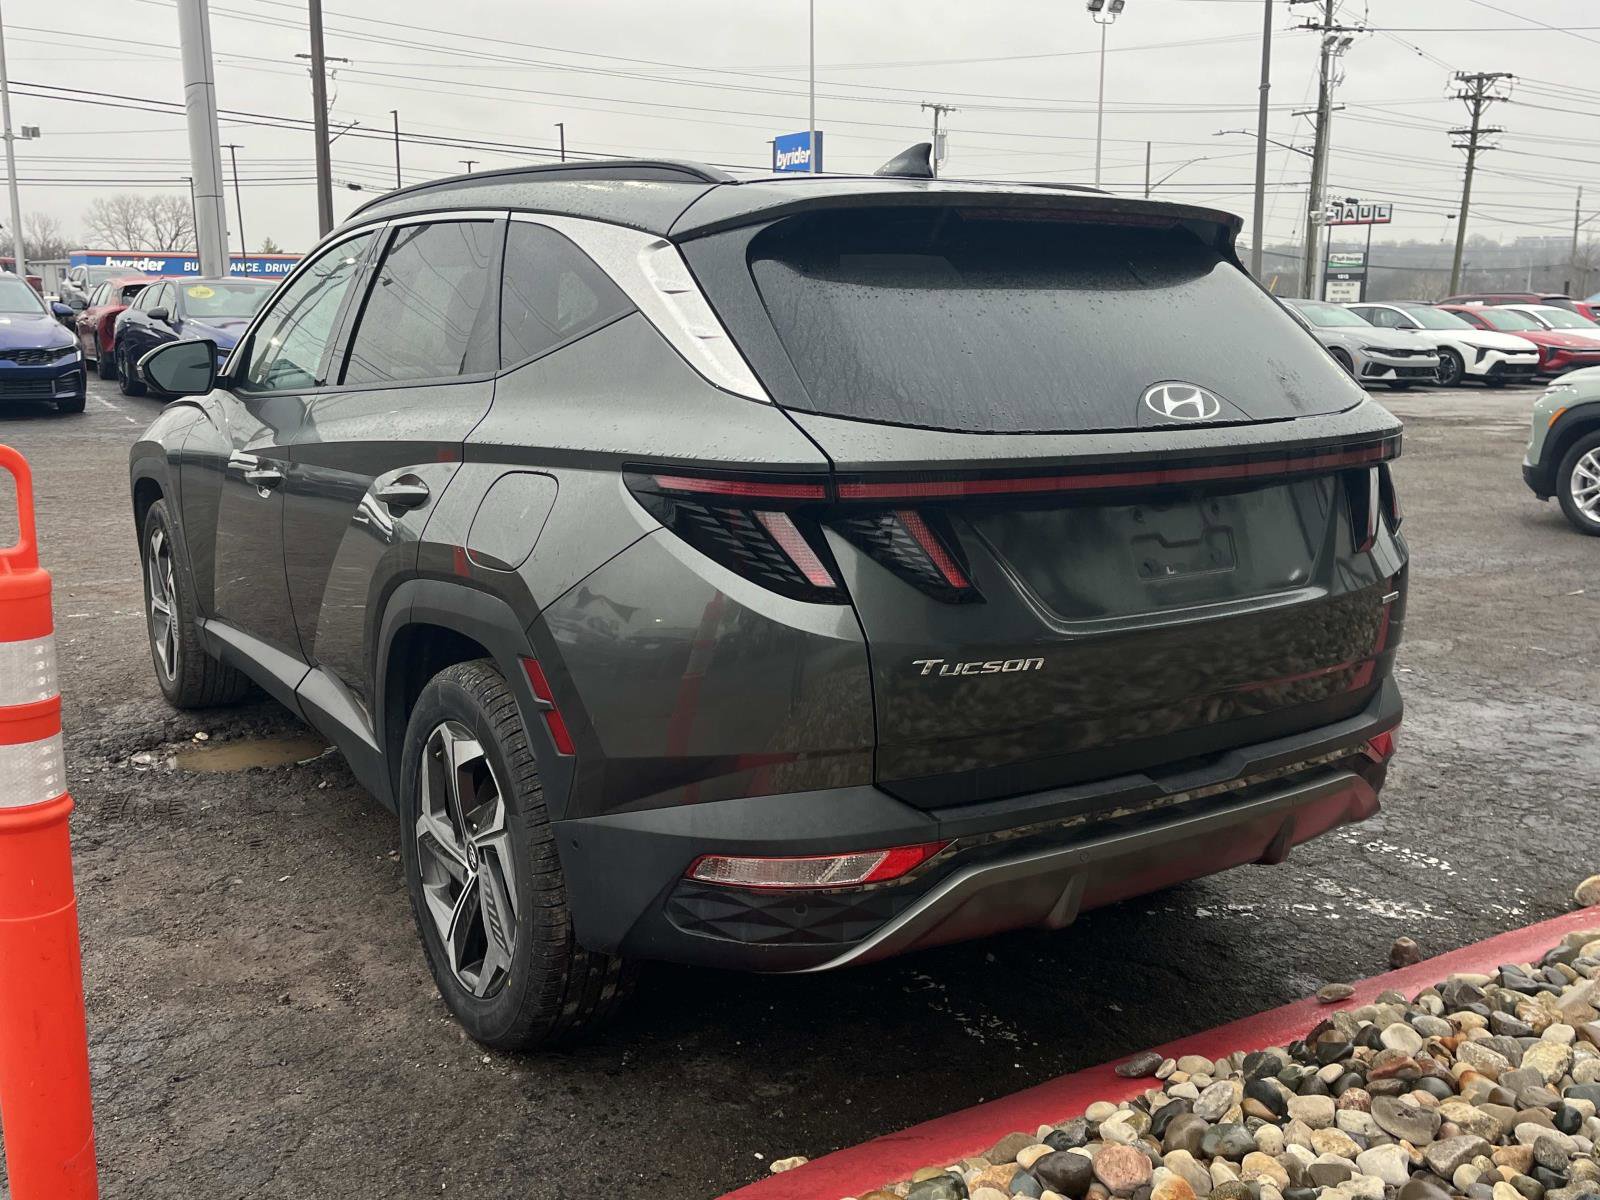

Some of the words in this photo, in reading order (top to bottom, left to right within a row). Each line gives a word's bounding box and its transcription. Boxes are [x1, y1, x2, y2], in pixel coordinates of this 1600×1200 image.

[777, 147, 811, 169] byrider
[183, 261, 199, 272] BU
[229, 262, 262, 273] ANCE.
